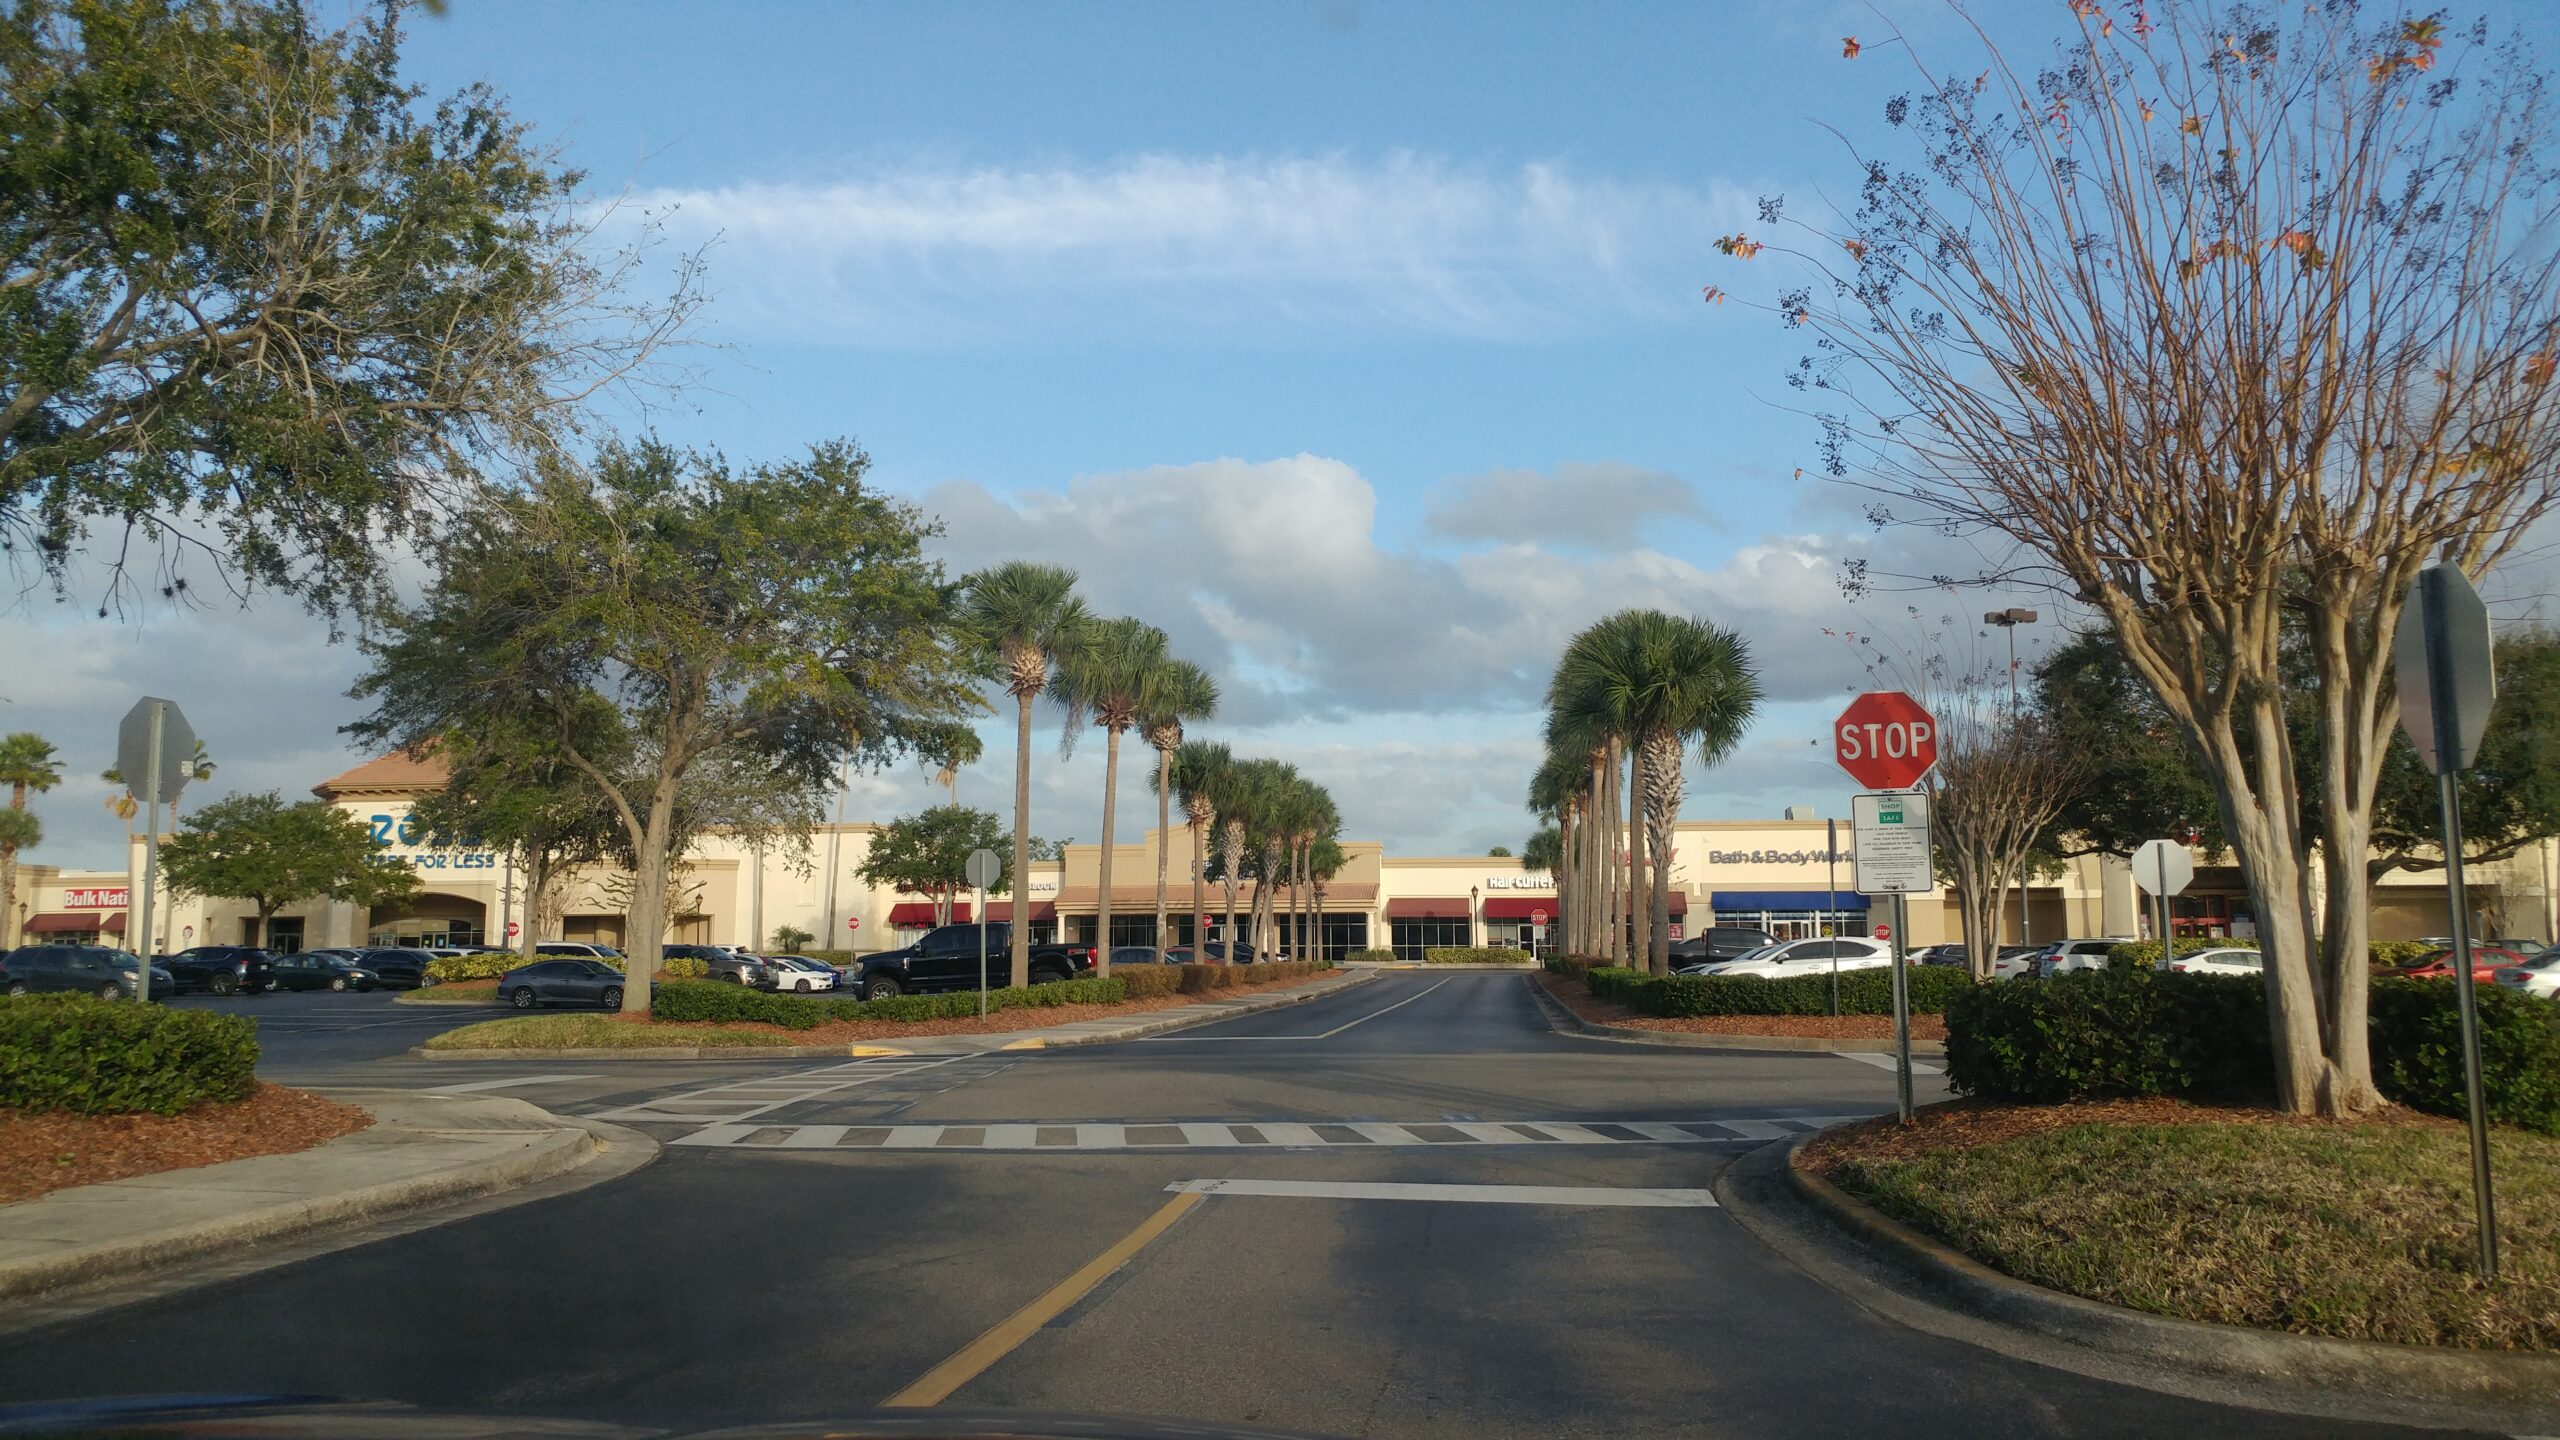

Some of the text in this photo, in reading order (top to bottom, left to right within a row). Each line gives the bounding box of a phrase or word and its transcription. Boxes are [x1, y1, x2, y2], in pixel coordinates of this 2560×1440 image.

[1841, 722, 1931, 760] STOP
[415, 855, 447, 869] FOR
[454, 854, 495, 869] LESS
[1709, 850, 1748, 864] Bath
[1749, 850, 1764, 864] &
[1765, 849, 1810, 867] Body
[64, 890, 128, 906] Bulk Nati
